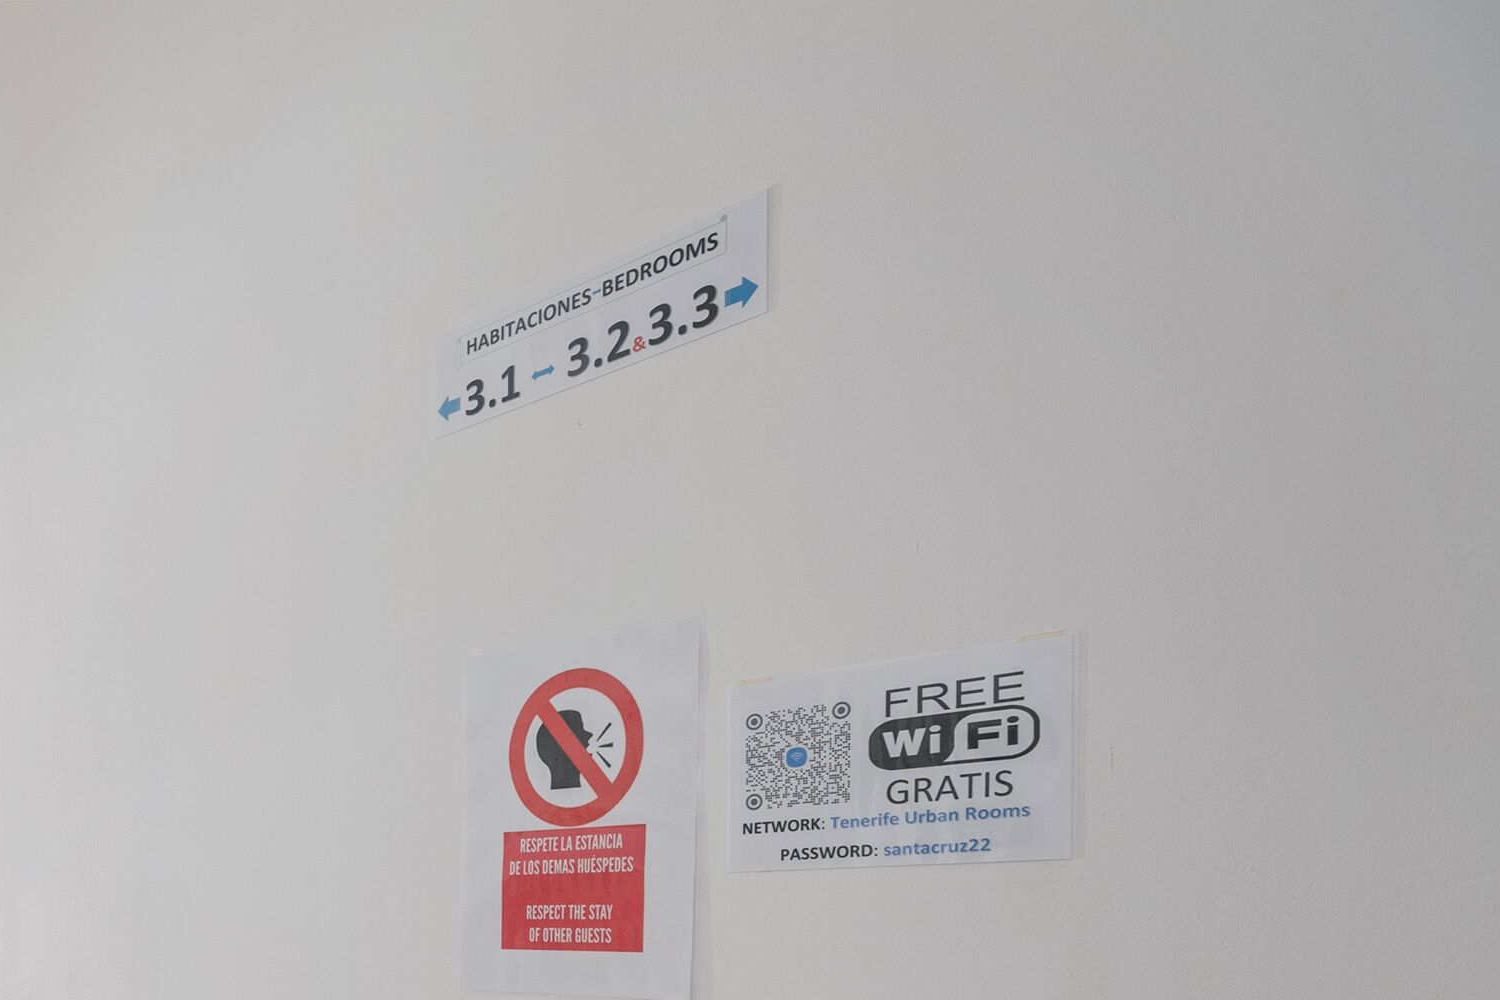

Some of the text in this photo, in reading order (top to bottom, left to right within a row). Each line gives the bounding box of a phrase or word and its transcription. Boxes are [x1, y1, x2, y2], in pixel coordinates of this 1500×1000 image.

[465, 365, 520, 416] 3.1
[885, 671, 1025, 717] FREE
[887, 770, 1013, 804] GRATIS
[743, 805, 1031, 834] NETWORK: Tenerife Urban Rooms
[520, 833, 623, 853] RESPETE LA ESTANCIA
[780, 838, 991, 860] PASSWORD: santacruz22
[509, 855, 634, 875] DE LOS DEMAS HUÉSPEDES
[526, 904, 613, 920] RESPECT THE STAY
[528, 927, 612, 943] OF OTHER GUESTS
